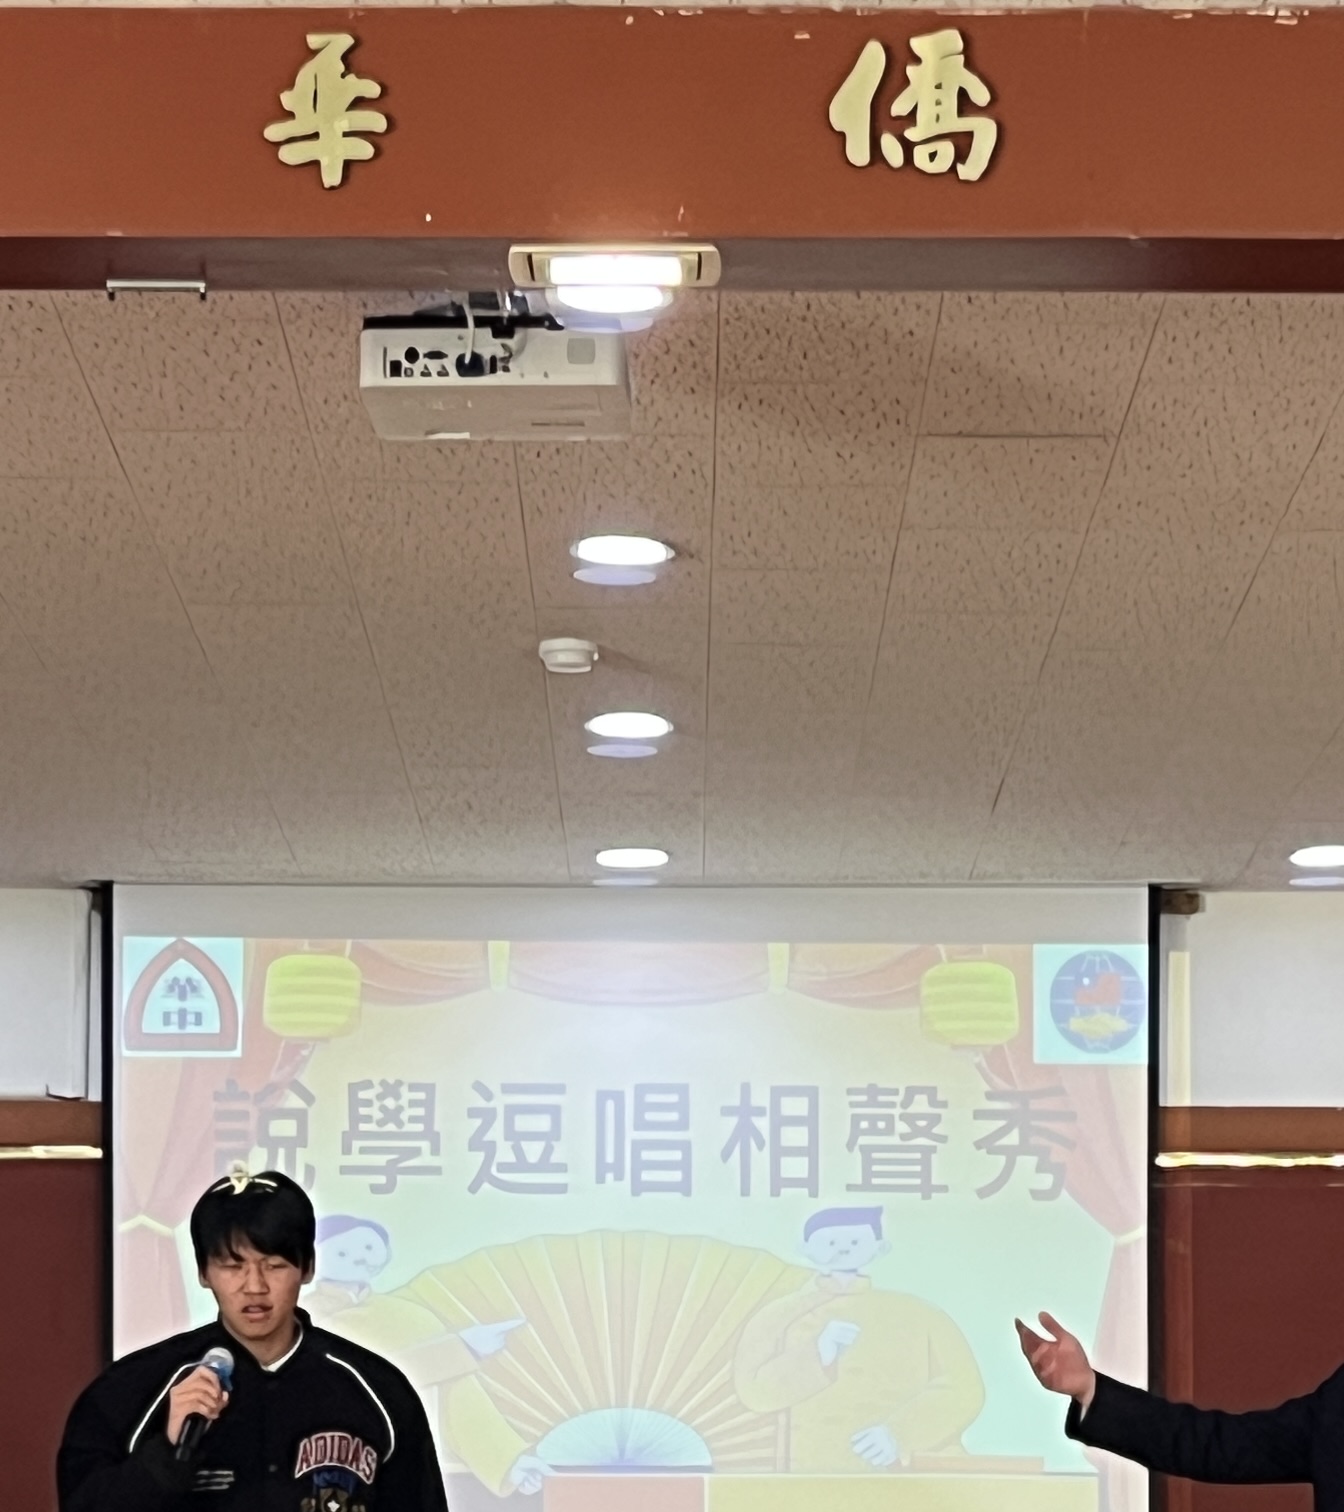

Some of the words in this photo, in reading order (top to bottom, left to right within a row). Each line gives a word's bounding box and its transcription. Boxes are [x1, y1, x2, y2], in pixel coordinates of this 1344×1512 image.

[212, 1077, 1080, 1204] 說學逗唱相聲秀
[294, 1431, 378, 1485] ADIDAS
